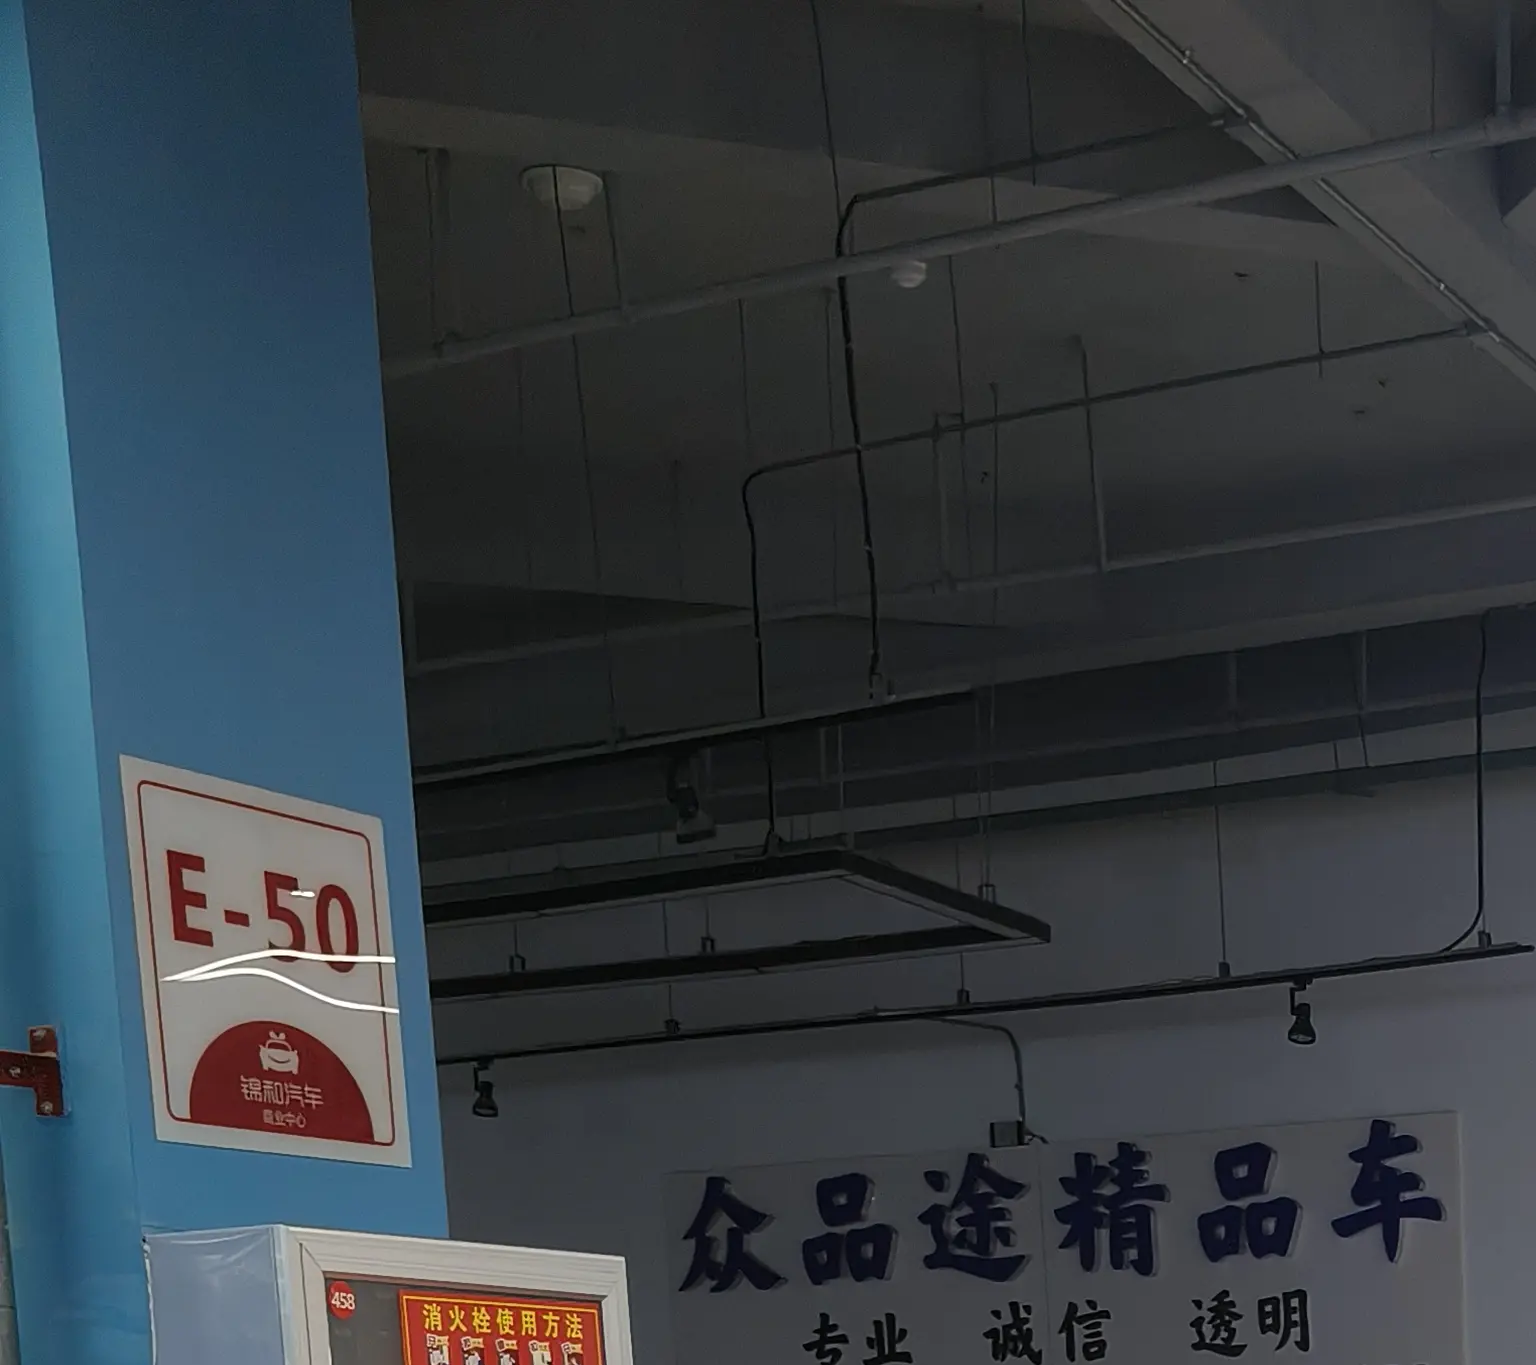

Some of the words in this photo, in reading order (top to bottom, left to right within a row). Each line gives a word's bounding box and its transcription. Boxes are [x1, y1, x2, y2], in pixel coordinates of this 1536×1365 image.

[166, 849, 359, 973] E-50
[677, 1118, 1448, 1294] 众品途精品车
[330, 1291, 356, 1310] 458
[422, 1302, 584, 1340] 消火栓使用方法
[1188, 1289, 1311, 1361] 透明
